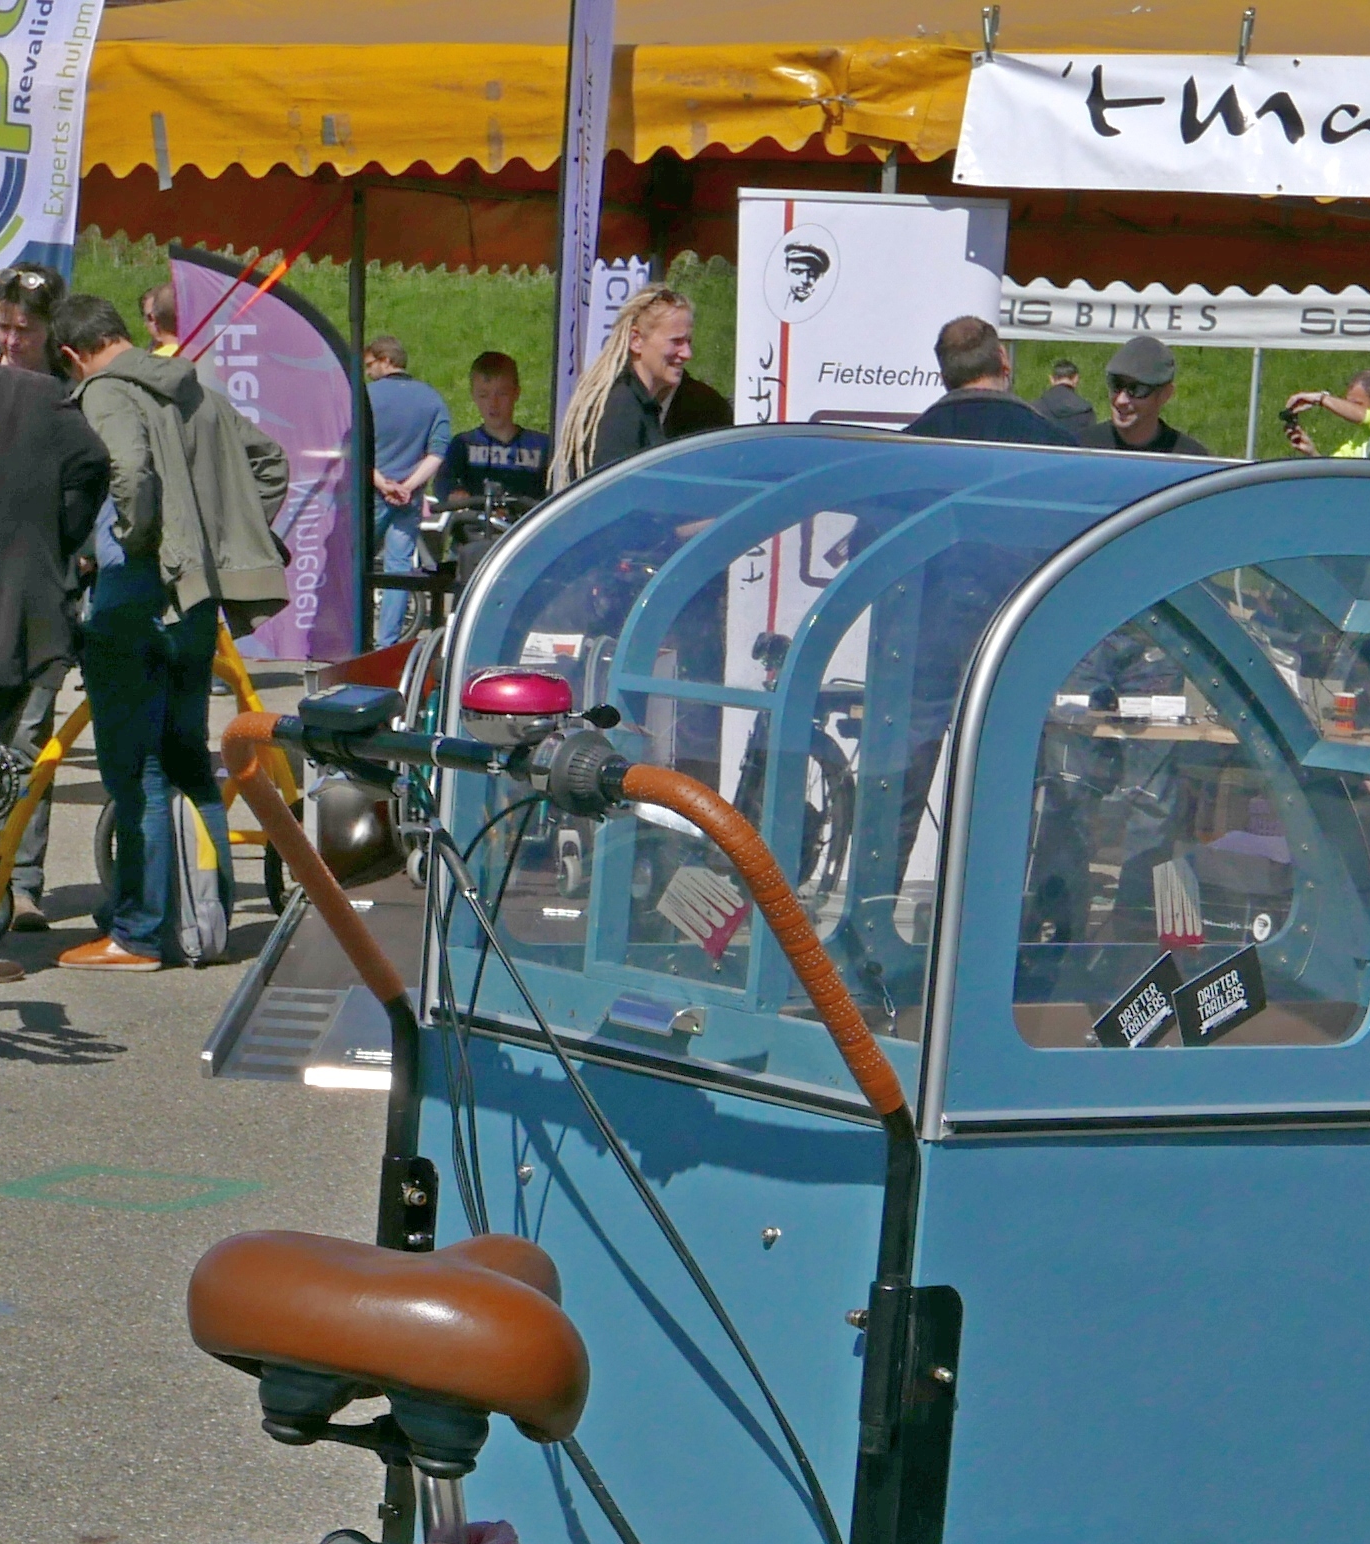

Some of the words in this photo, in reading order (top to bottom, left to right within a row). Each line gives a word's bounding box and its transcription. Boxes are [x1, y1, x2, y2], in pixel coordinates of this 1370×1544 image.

[53, 86, 75, 112] in
[43, 120, 72, 217] Experts
[1074, 302, 1218, 332] BIKES
[1117, 981, 1160, 1028] DRIFTER
[1196, 969, 1240, 1006] DRIFTER
[1197, 982, 1245, 1022] TRAILERS
[1120, 991, 1167, 1041] TRAILERS
